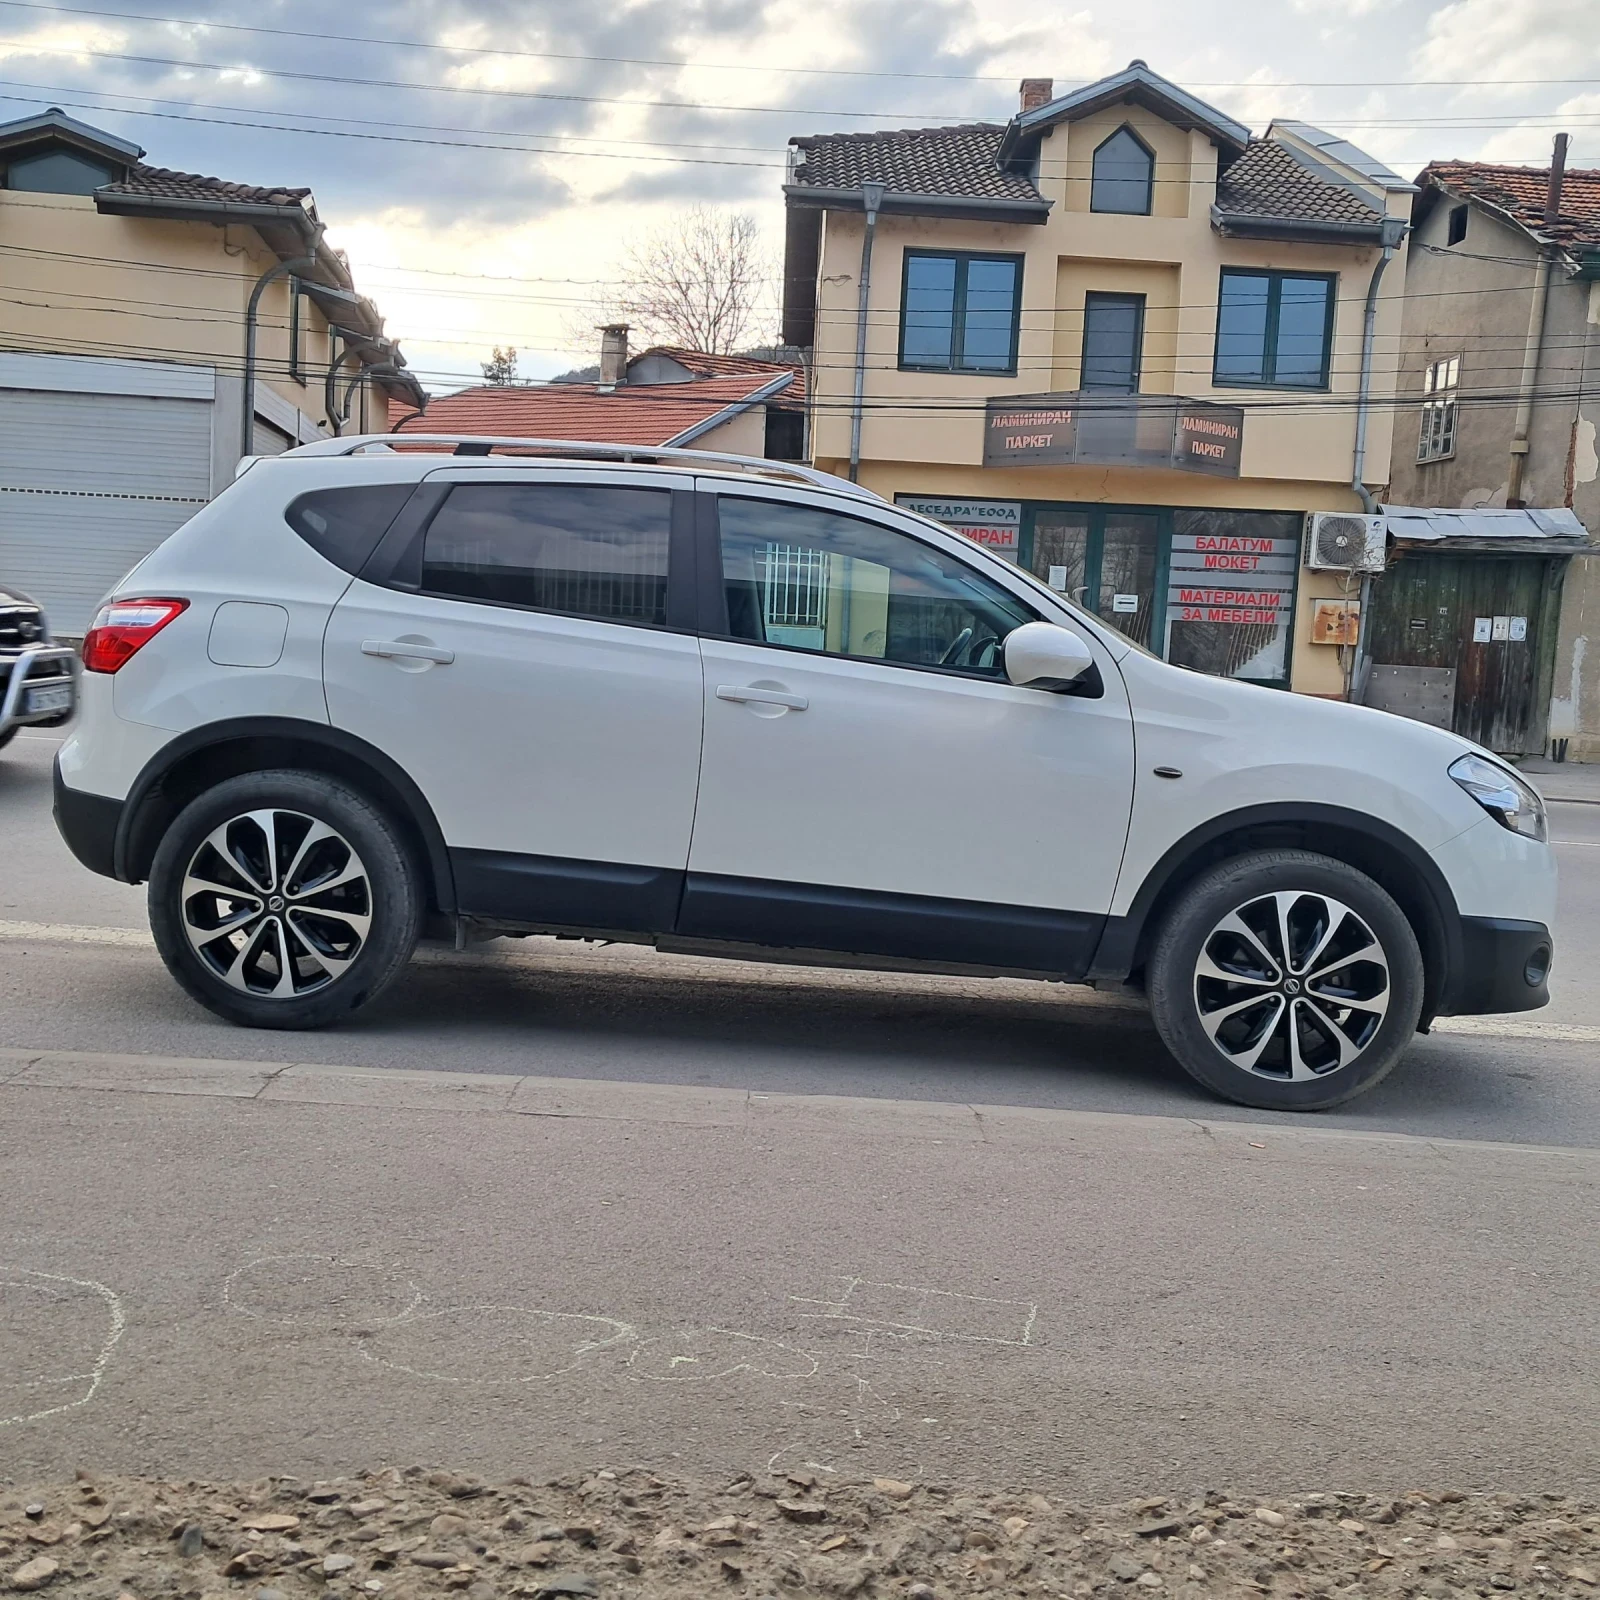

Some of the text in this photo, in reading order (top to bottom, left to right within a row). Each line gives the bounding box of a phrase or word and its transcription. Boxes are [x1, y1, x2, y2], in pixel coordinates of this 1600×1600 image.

[991, 410, 1072, 428] ЛАМИНИРАН
[1182, 416, 1239, 439] ЛАМИНИРАН
[1005, 434, 1053, 449] ПАРКЕТ
[1191, 441, 1226, 458] ПАРКЕТ
[1195, 536, 1273, 552] БАЛАТУМ
[1204, 555, 1260, 569] МОКЕТ
[1180, 589, 1280, 606] МАТЕРИАЛИ
[1182, 607, 1276, 624] ЗА МЕБЕЛИ
